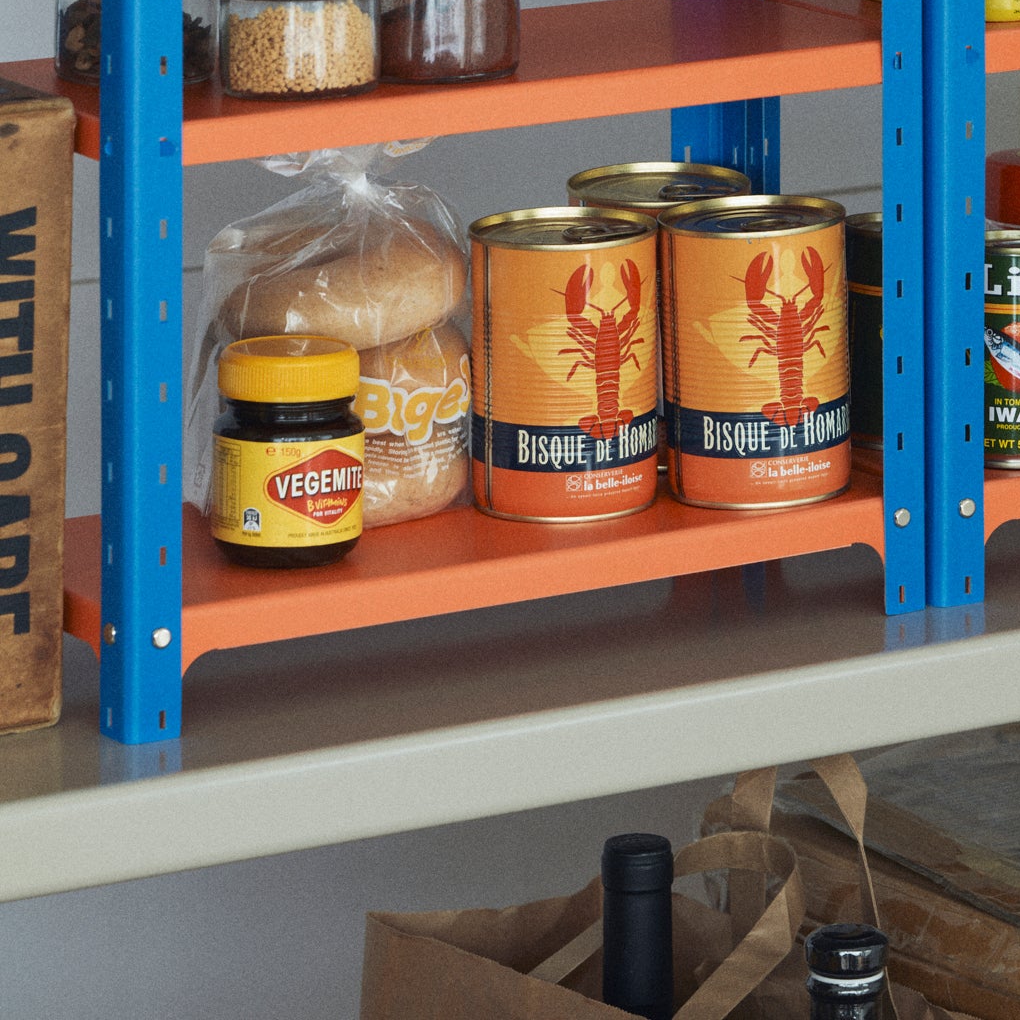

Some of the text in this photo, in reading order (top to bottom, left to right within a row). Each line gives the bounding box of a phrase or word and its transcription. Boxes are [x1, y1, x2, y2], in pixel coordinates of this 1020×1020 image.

[517, 429, 588, 471] BISQUE
[596, 438, 613, 463] DE
[618, 418, 658, 460] HOMAR
[702, 415, 771, 456] BISQUE
[780, 425, 799, 450] DE
[984, 438, 997, 447] ET
[998, 438, 1015, 449] WT
[768, 459, 831, 478] la belle-iloise
[275, 466, 362, 499] VEGEMITE
[583, 472, 643, 491] la belle-iloise
[306, 499, 315, 513] B
